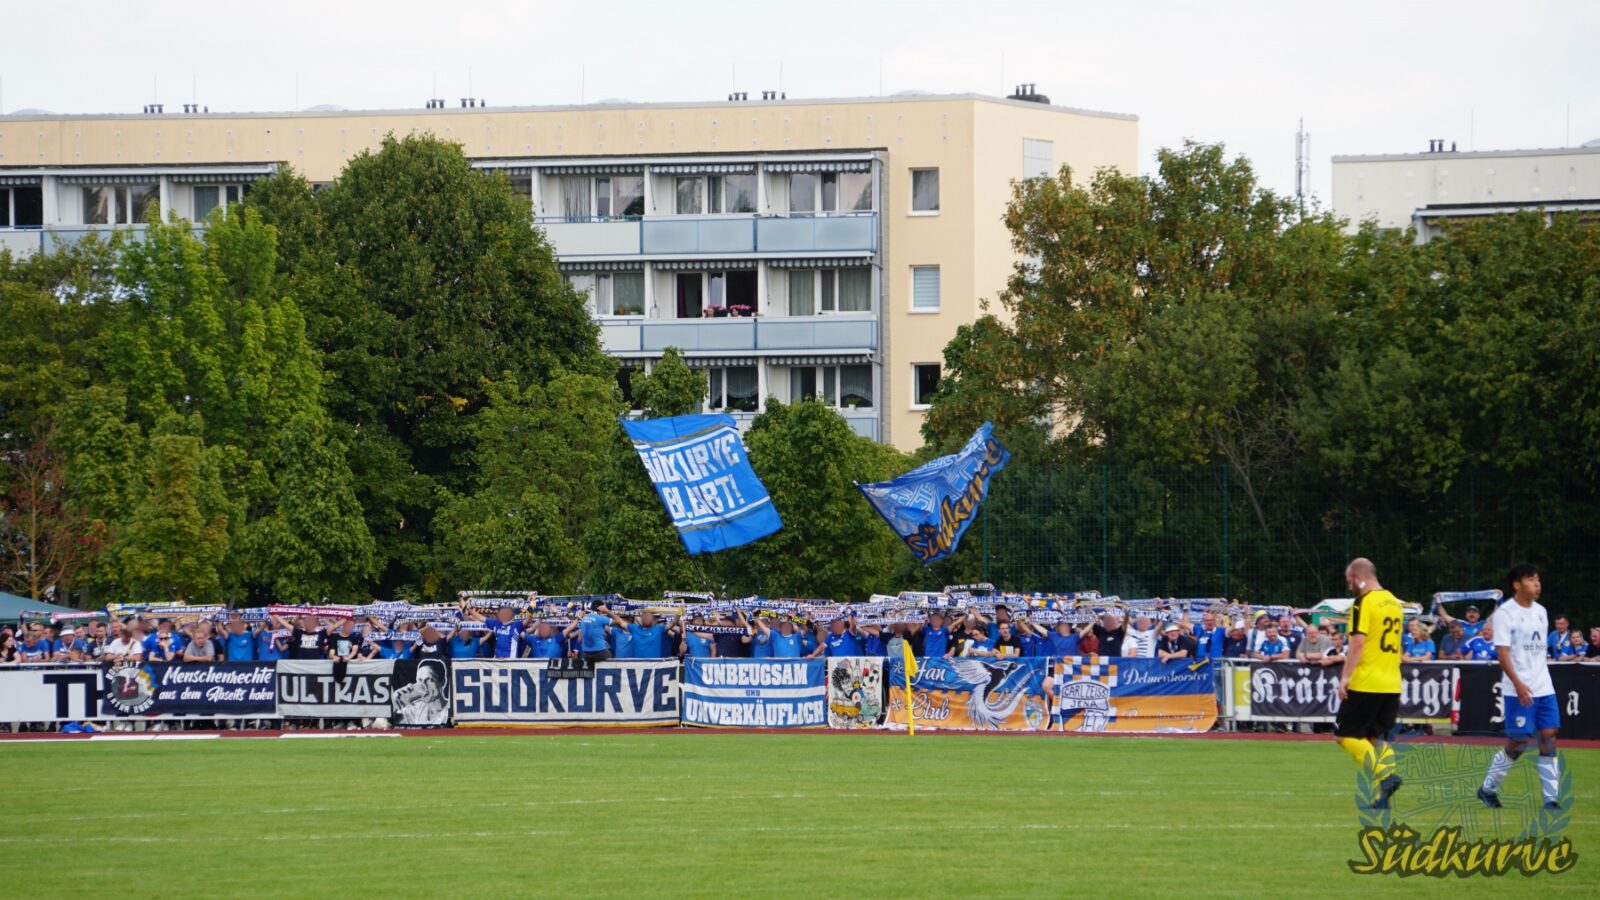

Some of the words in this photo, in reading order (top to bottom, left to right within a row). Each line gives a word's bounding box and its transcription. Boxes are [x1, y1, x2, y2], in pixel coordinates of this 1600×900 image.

[162, 666, 275, 686] Menschenrechte
[702, 663, 808, 686] UNBEUGSAM
[159, 690, 177, 701] aus
[180, 687, 202, 700] dem
[206, 686, 247, 702] Abseits
[248, 688, 274, 701] holen
[280, 675, 391, 703] ULTRAS
[455, 668, 677, 713] SÜDKURVE
[745, 689, 761, 697] UND
[1064, 685, 1084, 698] CARL
[1085, 685, 1106, 699] ZEISS
[685, 699, 824, 726] UNVERKÄUFLICH
[906, 693, 950, 721] Club
[1070, 700, 1098, 708] JENA
